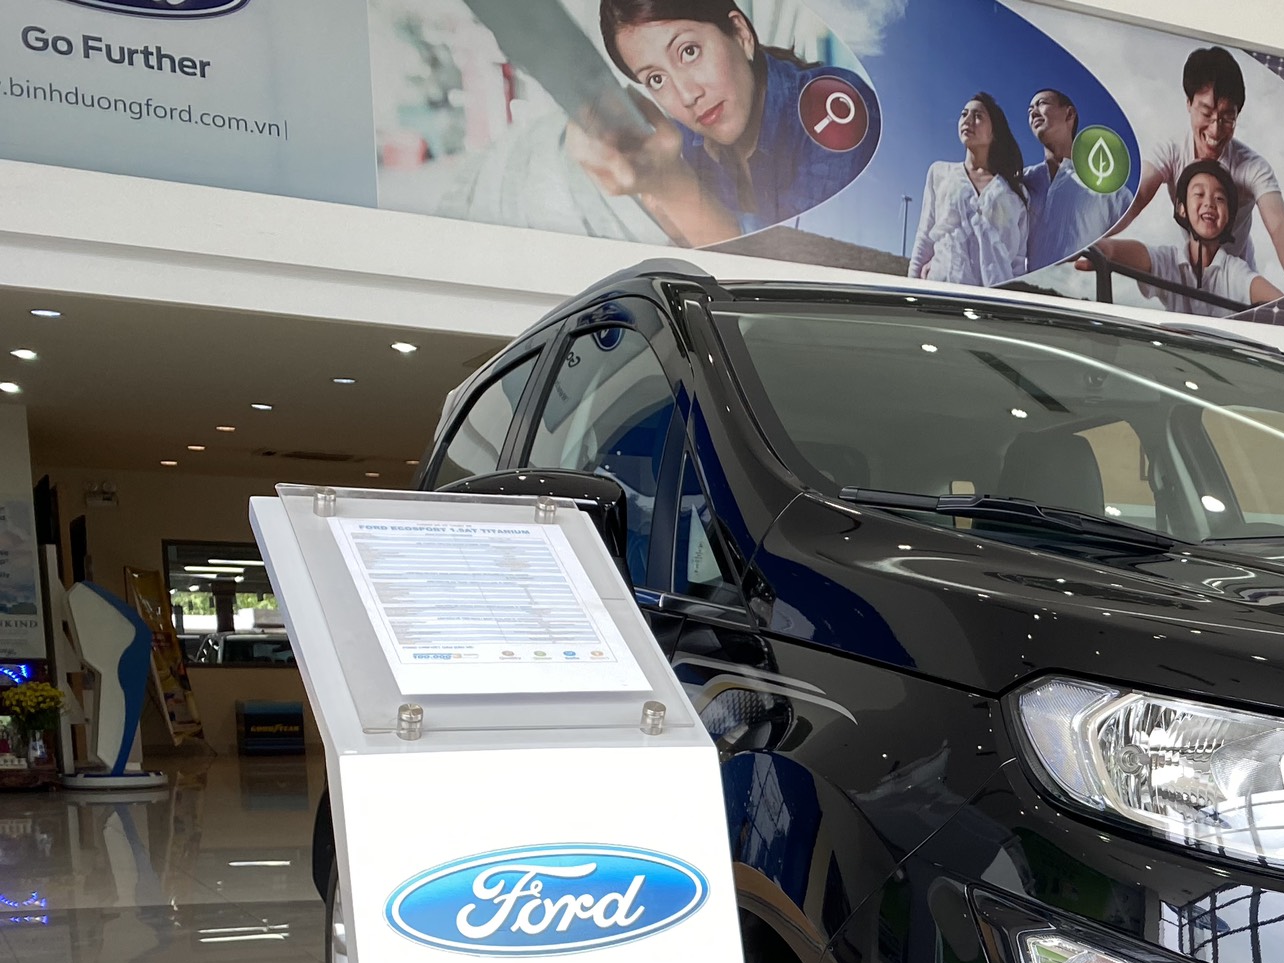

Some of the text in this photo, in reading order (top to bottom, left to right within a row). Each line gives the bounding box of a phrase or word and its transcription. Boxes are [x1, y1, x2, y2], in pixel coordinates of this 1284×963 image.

[21, 25, 211, 78] Go Further
[0, 620, 38, 628] KIND
[456, 862, 646, 940] Ford
